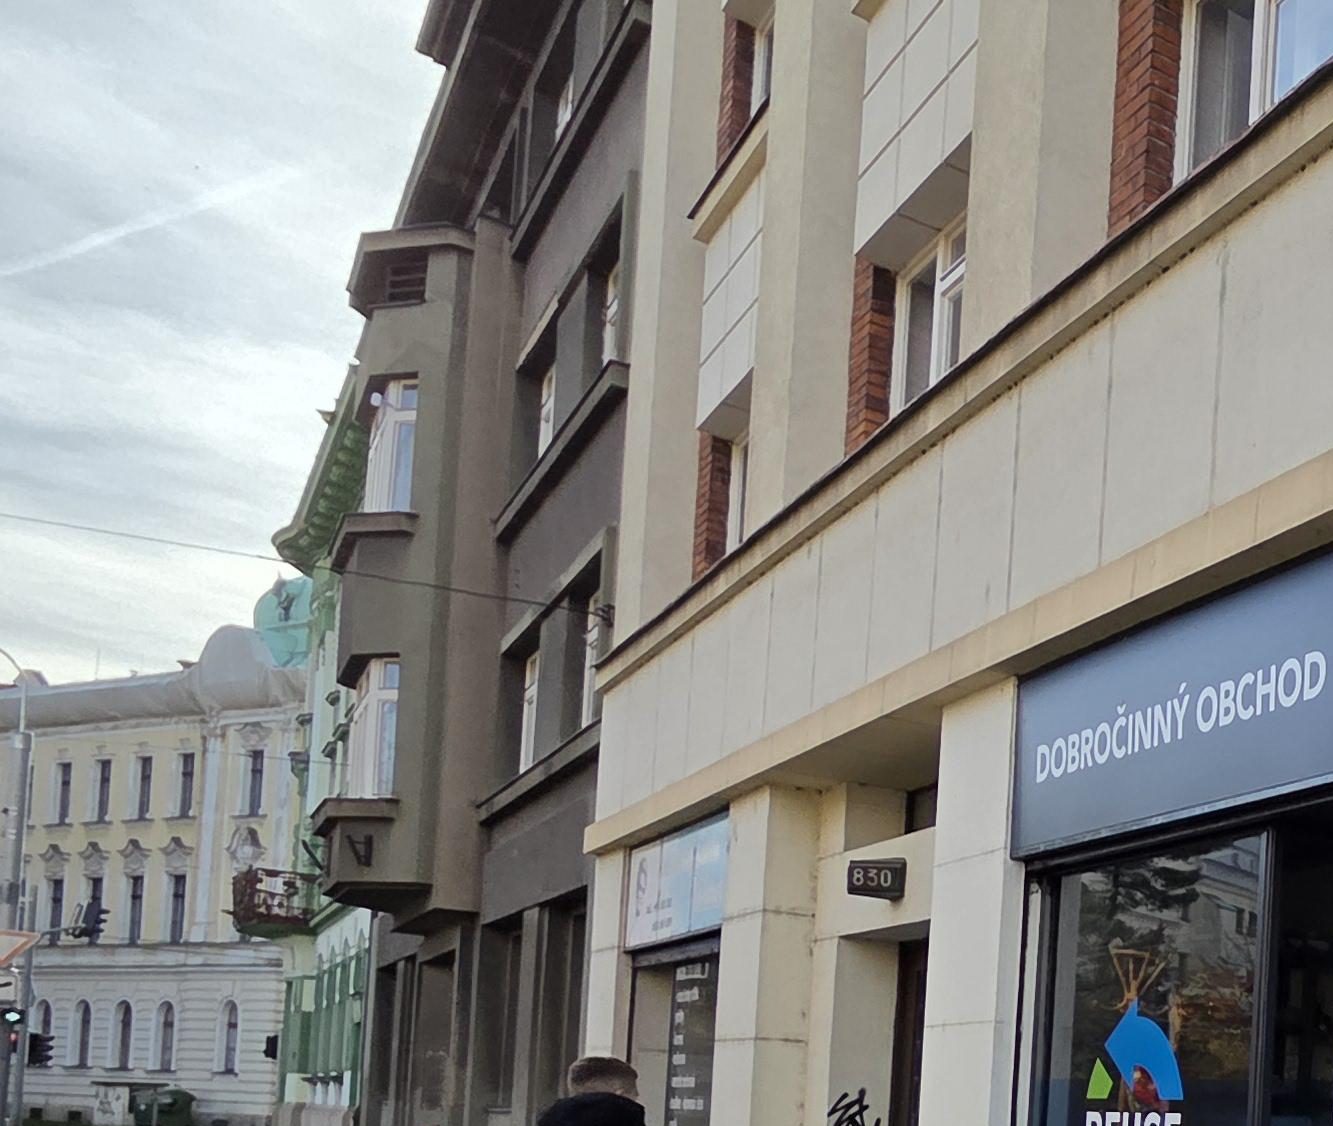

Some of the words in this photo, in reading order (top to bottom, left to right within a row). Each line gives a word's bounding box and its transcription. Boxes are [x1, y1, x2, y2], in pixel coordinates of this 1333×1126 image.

[1036, 682, 1190, 784] DOBROČINNÝ
[1196, 651, 1327, 733] OBCHOD
[852, 868, 892, 887] 830
